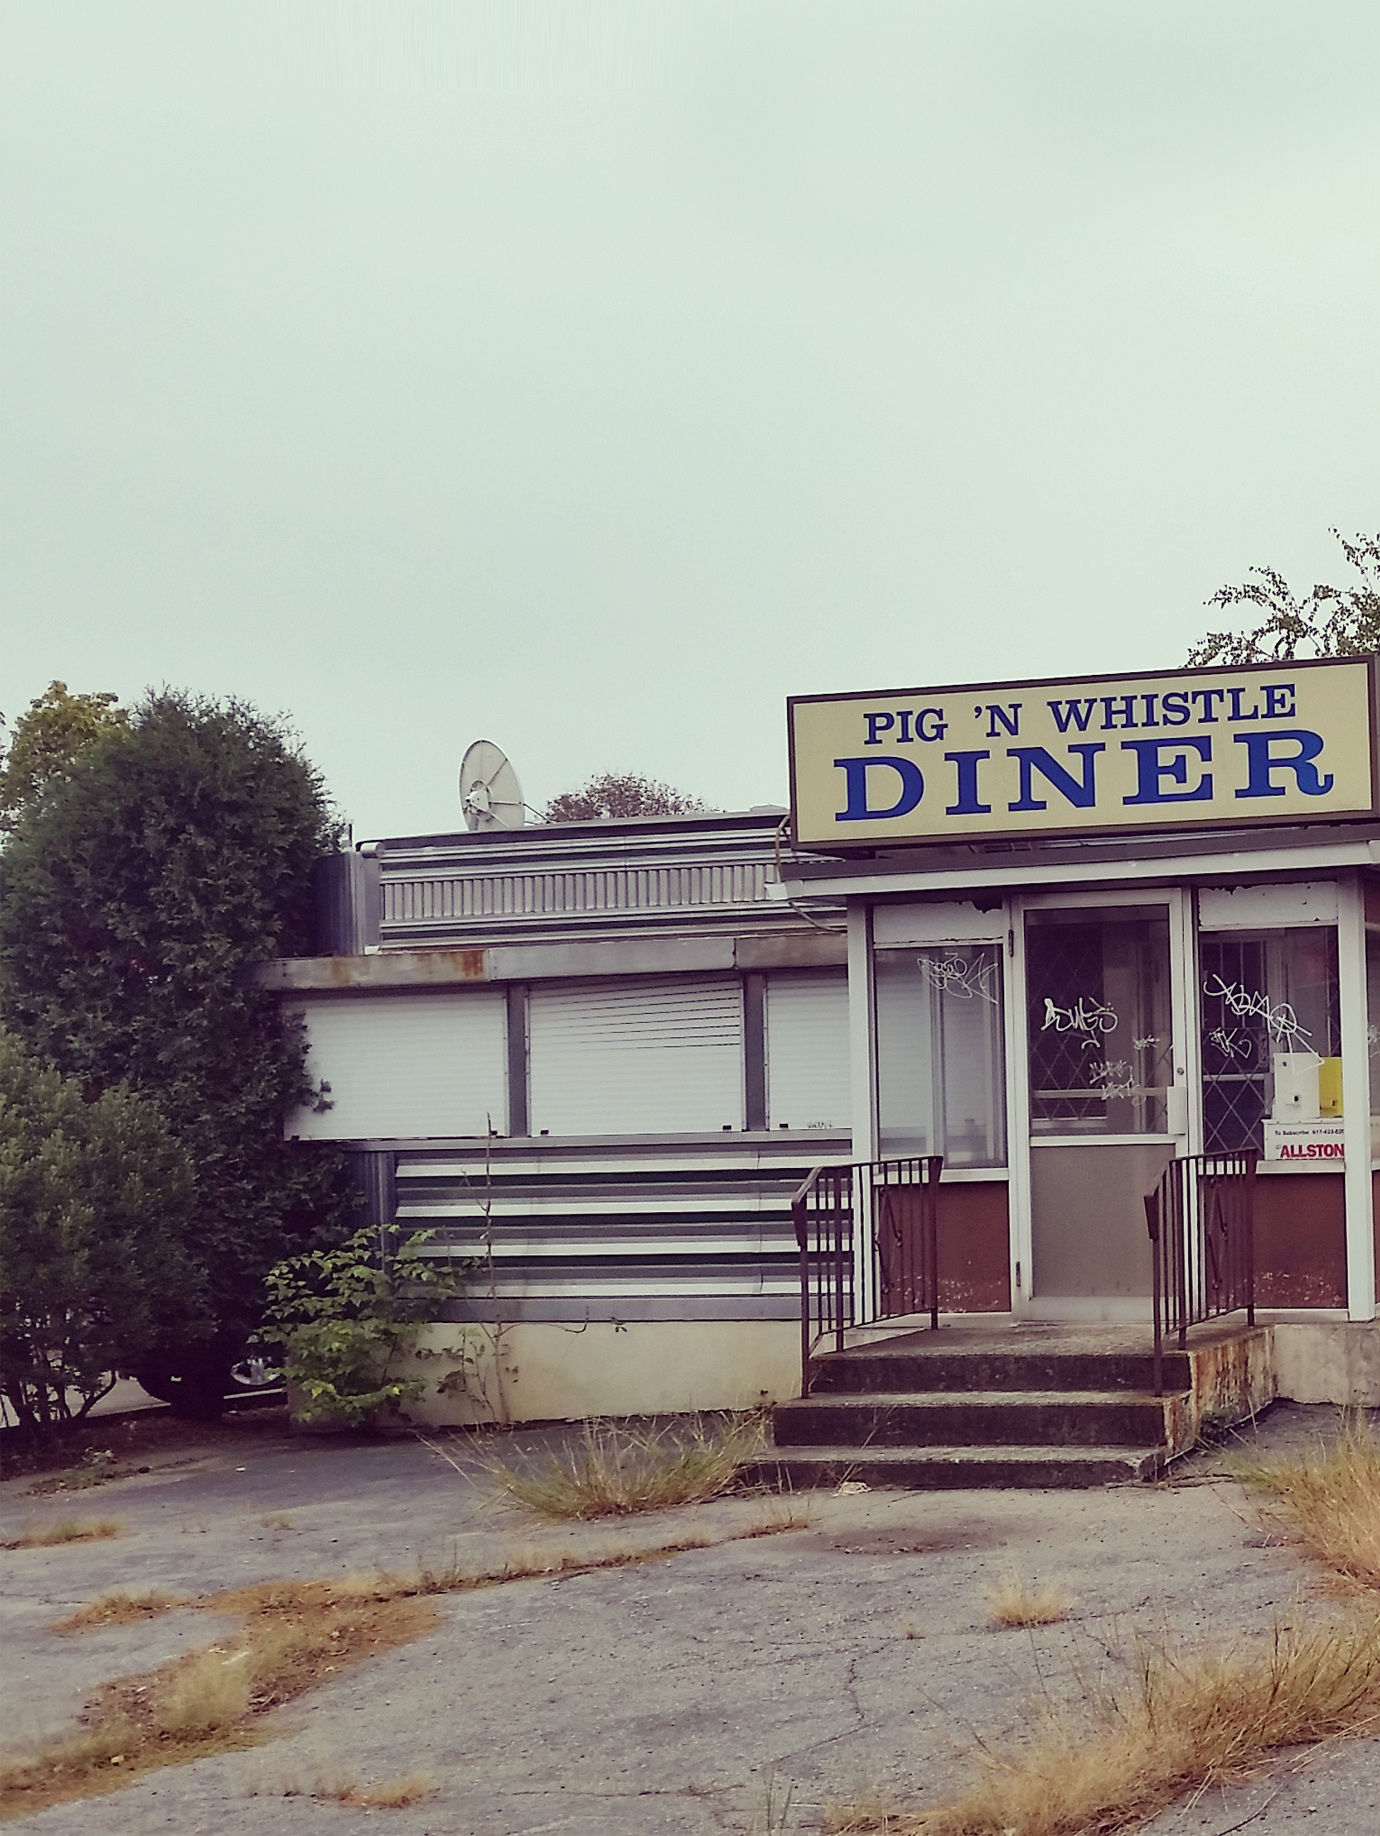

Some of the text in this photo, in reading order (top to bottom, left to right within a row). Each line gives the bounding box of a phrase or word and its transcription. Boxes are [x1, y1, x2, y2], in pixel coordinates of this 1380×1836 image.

[863, 707, 949, 746] PIG
[1046, 683, 1297, 734] WHISTLE
[832, 729, 1335, 823] DINER
[1280, 1143, 1345, 1158] ALLSTON
